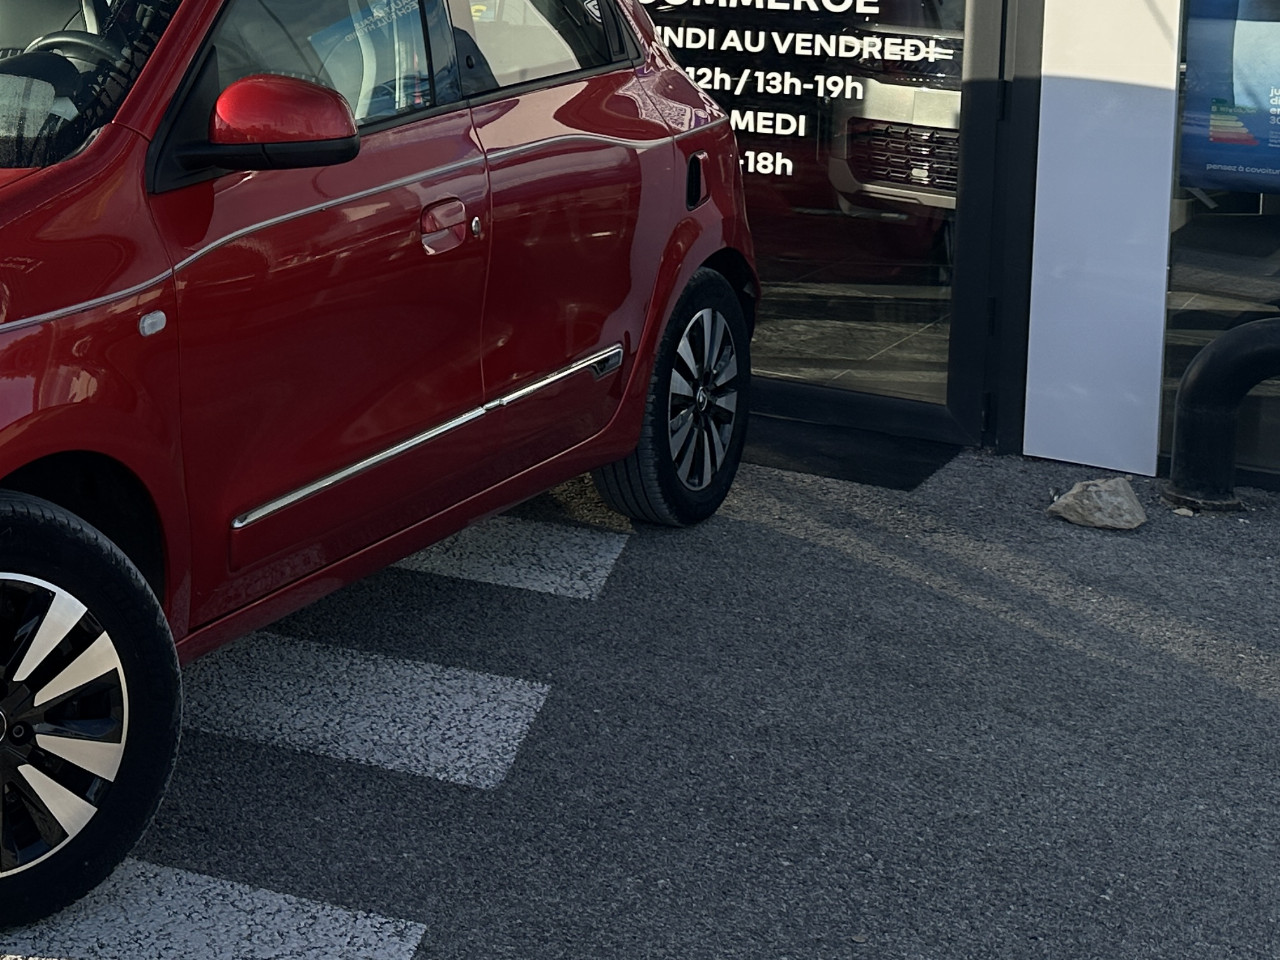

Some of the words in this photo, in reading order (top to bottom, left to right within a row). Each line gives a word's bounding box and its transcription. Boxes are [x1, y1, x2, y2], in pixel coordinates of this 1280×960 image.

[655, 26, 715, 51] NDI
[721, 30, 766, 52] AU
[772, 31, 936, 63] VENDREDI
[685, 67, 732, 91] 12h
[729, 110, 806, 137] MEDI
[739, 152, 793, 176] -18h
[1206, 163, 1237, 173] pensez
